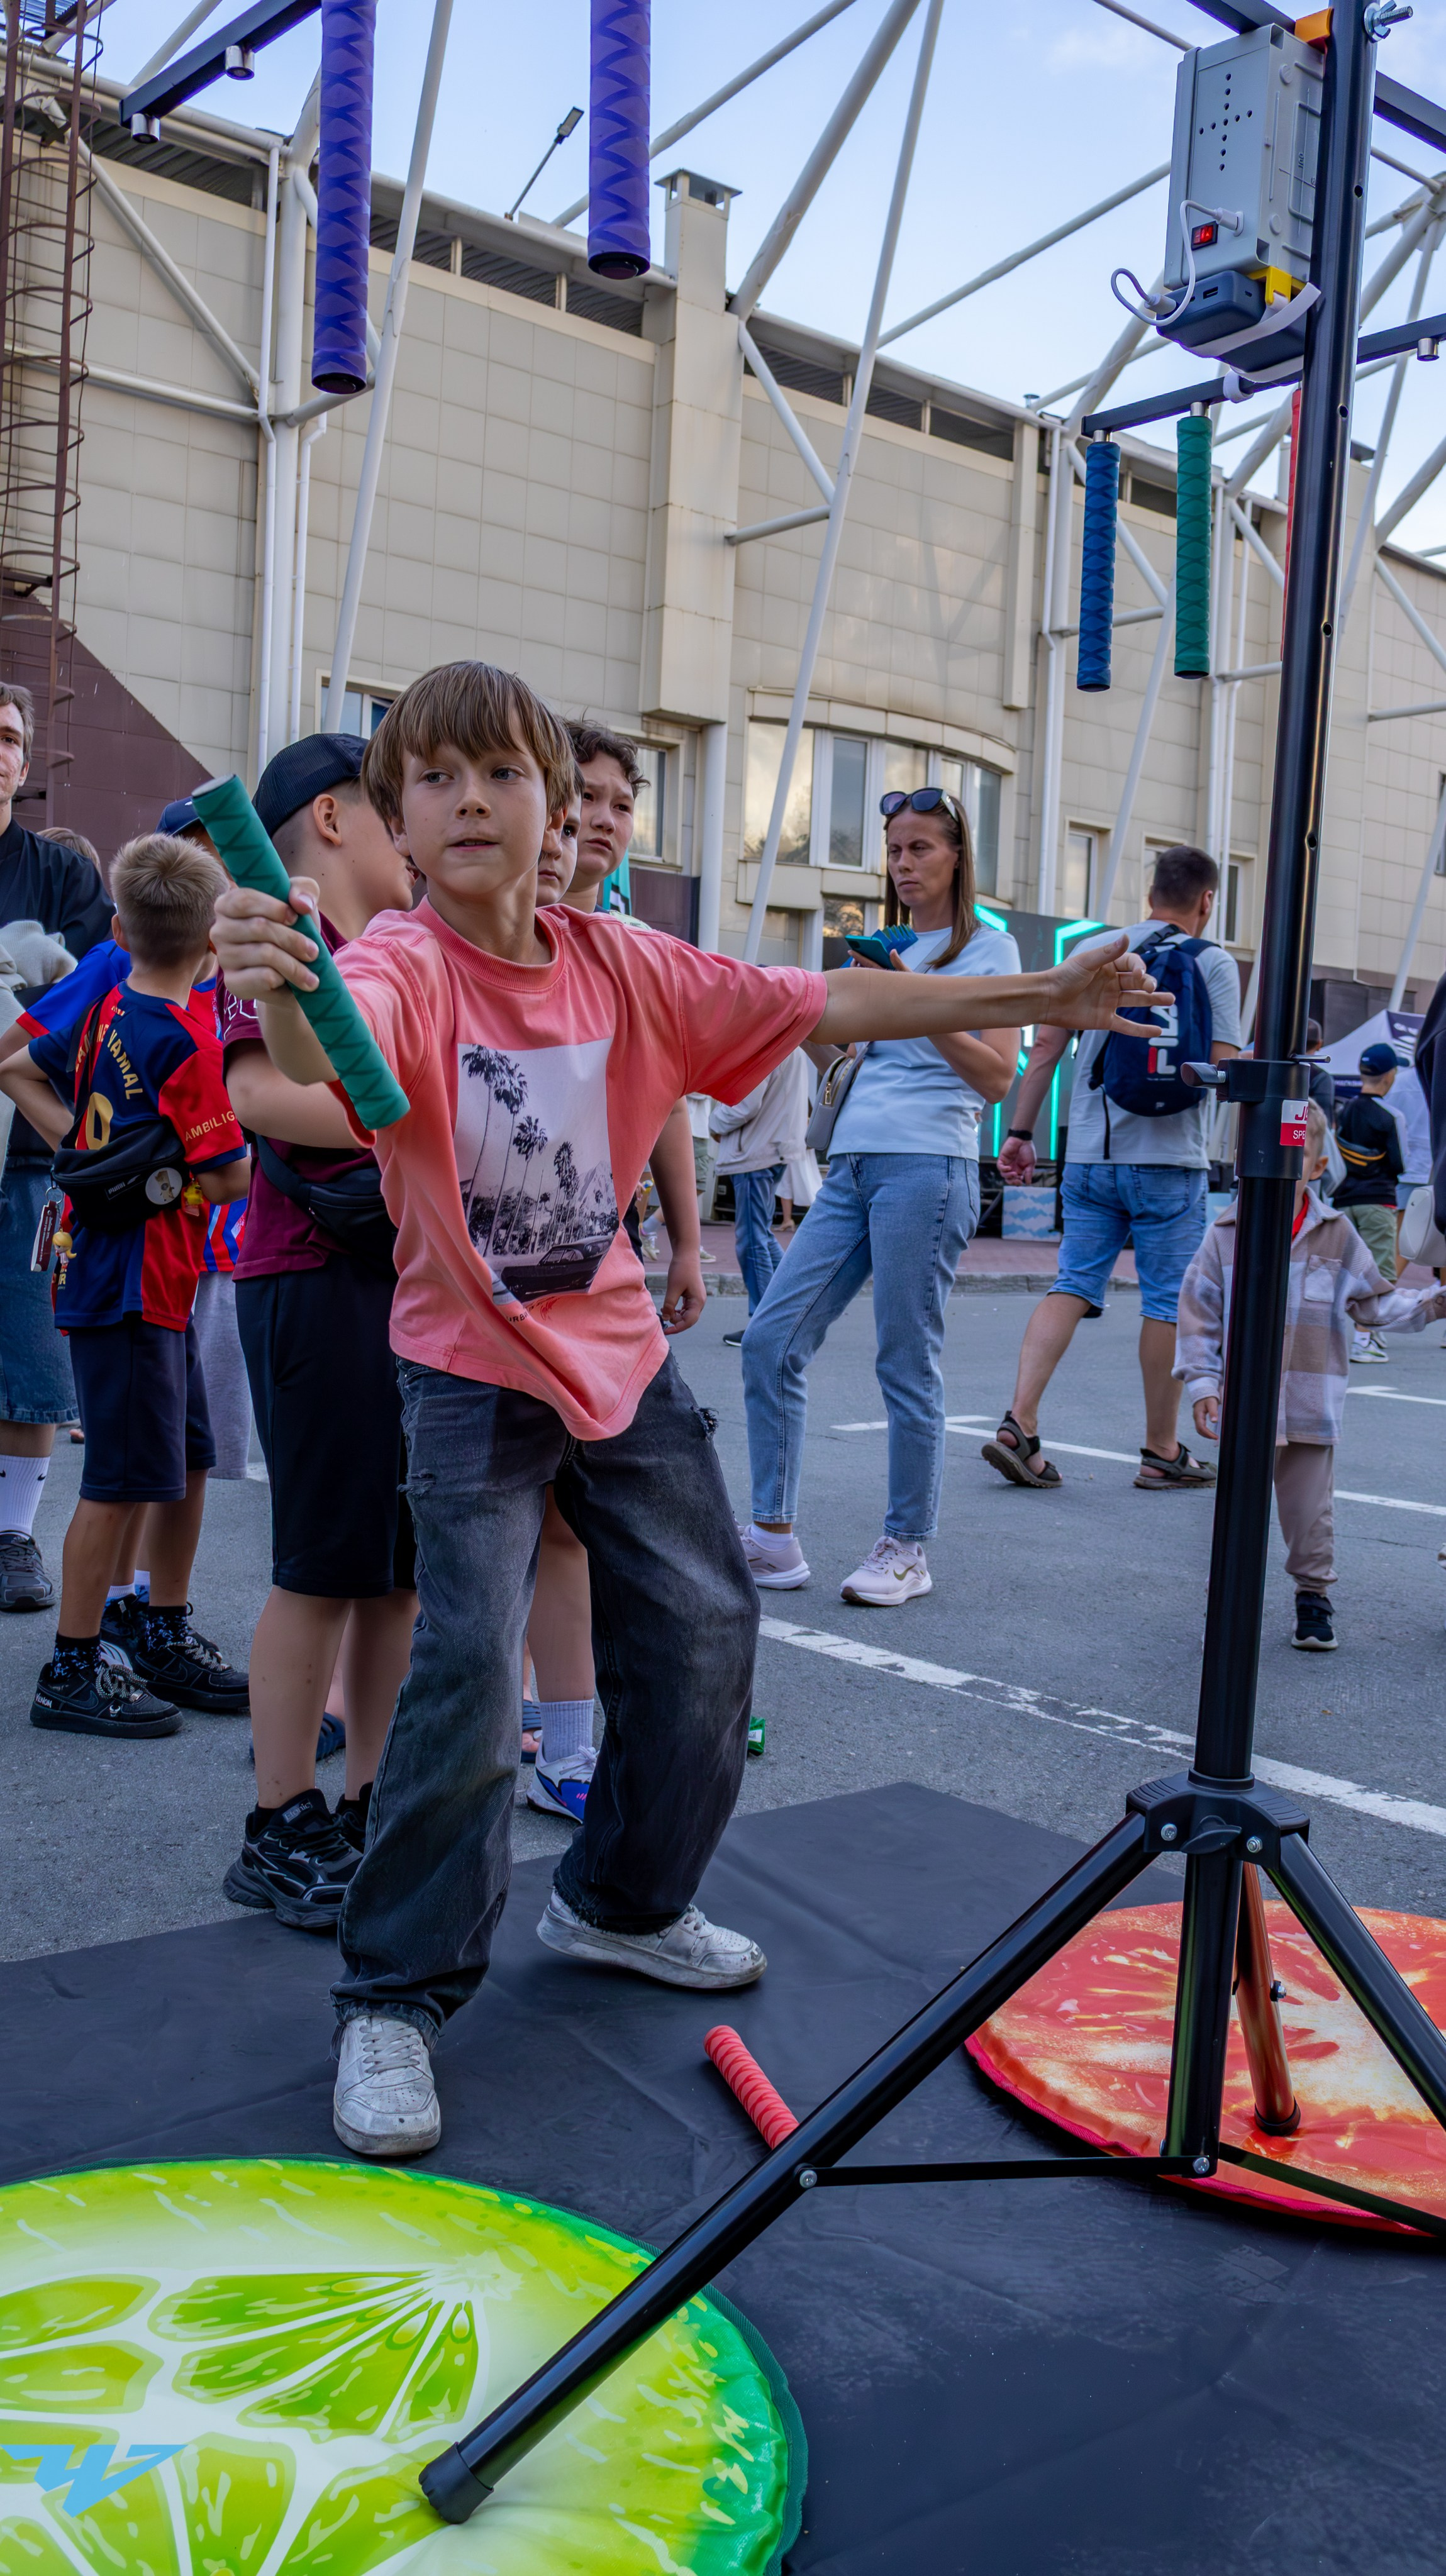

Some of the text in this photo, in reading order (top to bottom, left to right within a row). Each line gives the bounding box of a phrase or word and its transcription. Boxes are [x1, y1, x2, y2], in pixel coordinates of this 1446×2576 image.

[107, 1029, 143, 1100] YAMAL
[1147, 1004, 1178, 1075] FILA
[75, 1092, 114, 1150] 0
[186, 1111, 235, 1141] AMBILIG
[35, 1692, 52, 1708] VENOM
